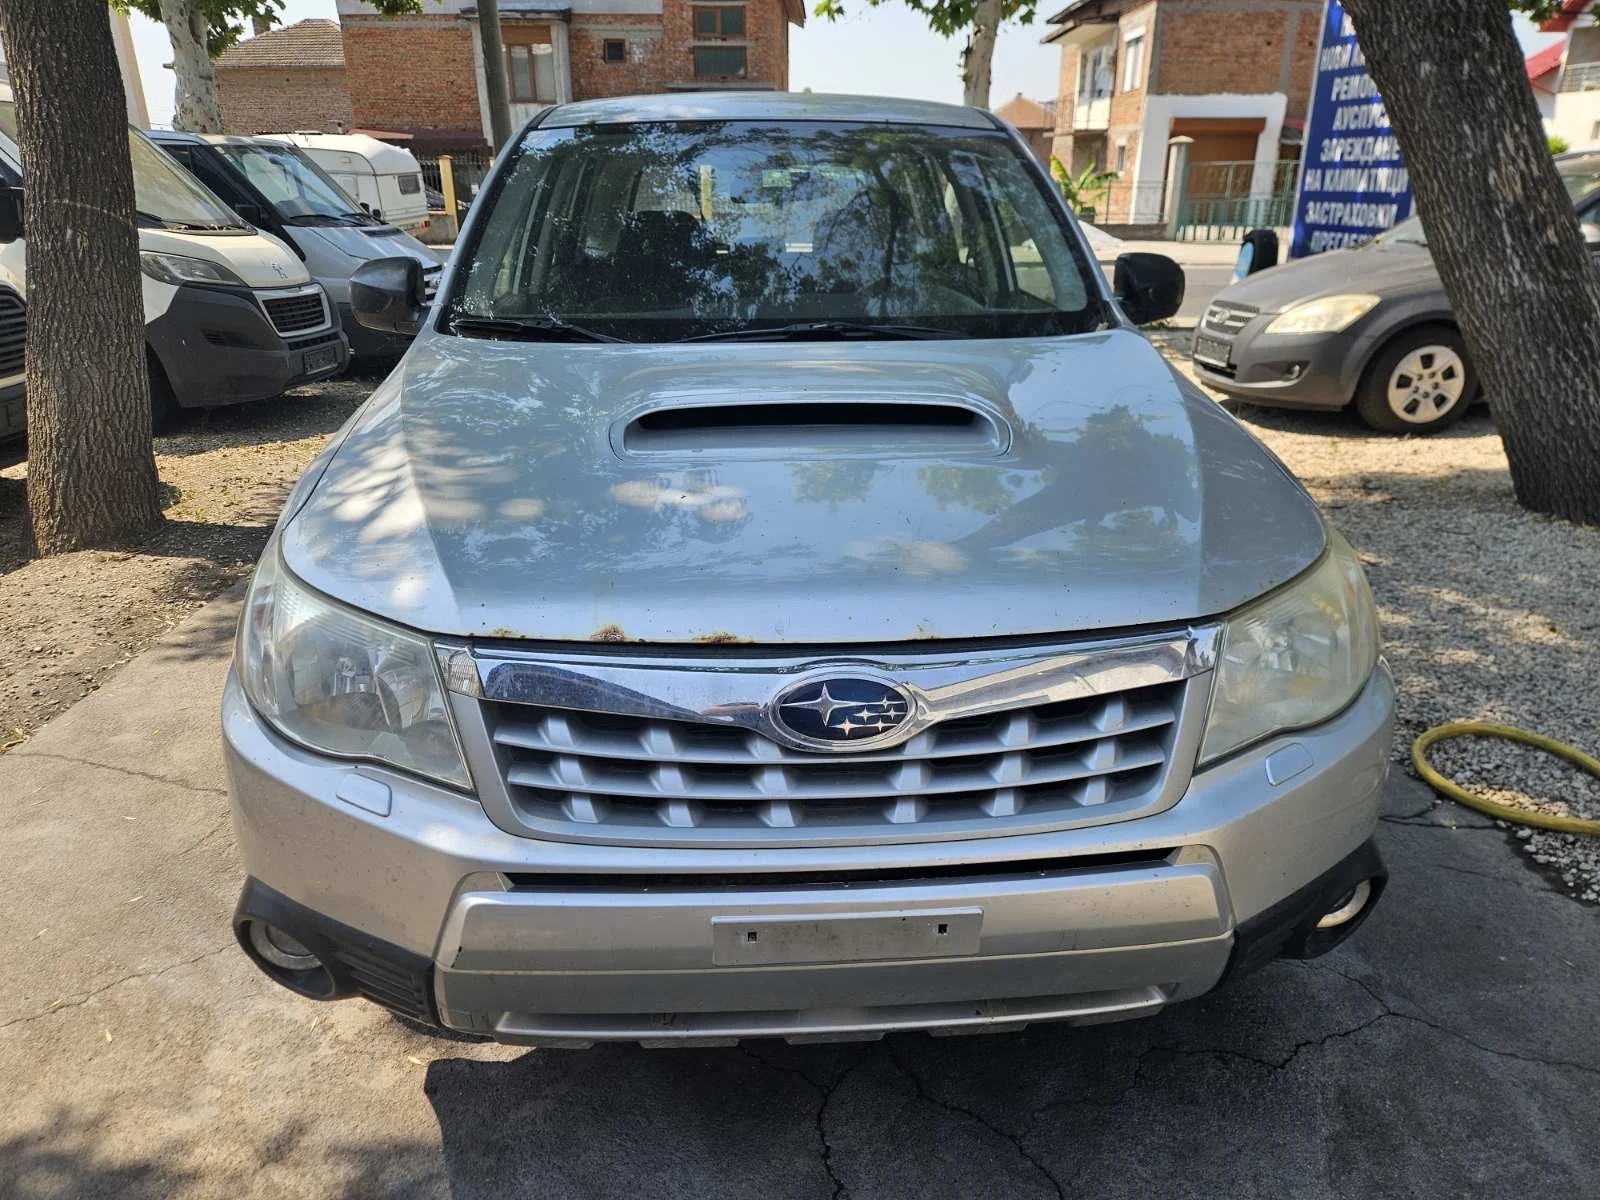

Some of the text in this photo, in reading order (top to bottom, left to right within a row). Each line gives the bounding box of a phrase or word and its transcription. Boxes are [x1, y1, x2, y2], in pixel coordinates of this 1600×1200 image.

[1331, 74, 1381, 102] РЕМОН
[1332, 103, 1392, 131] АУСПУС
[1320, 136, 1400, 166] ЗАРЕЖДАНЕ
[1304, 167, 1409, 198] НА КЛИМАТИЦИ
[1305, 200, 1398, 228] ЗАСТРАХОВКИ
